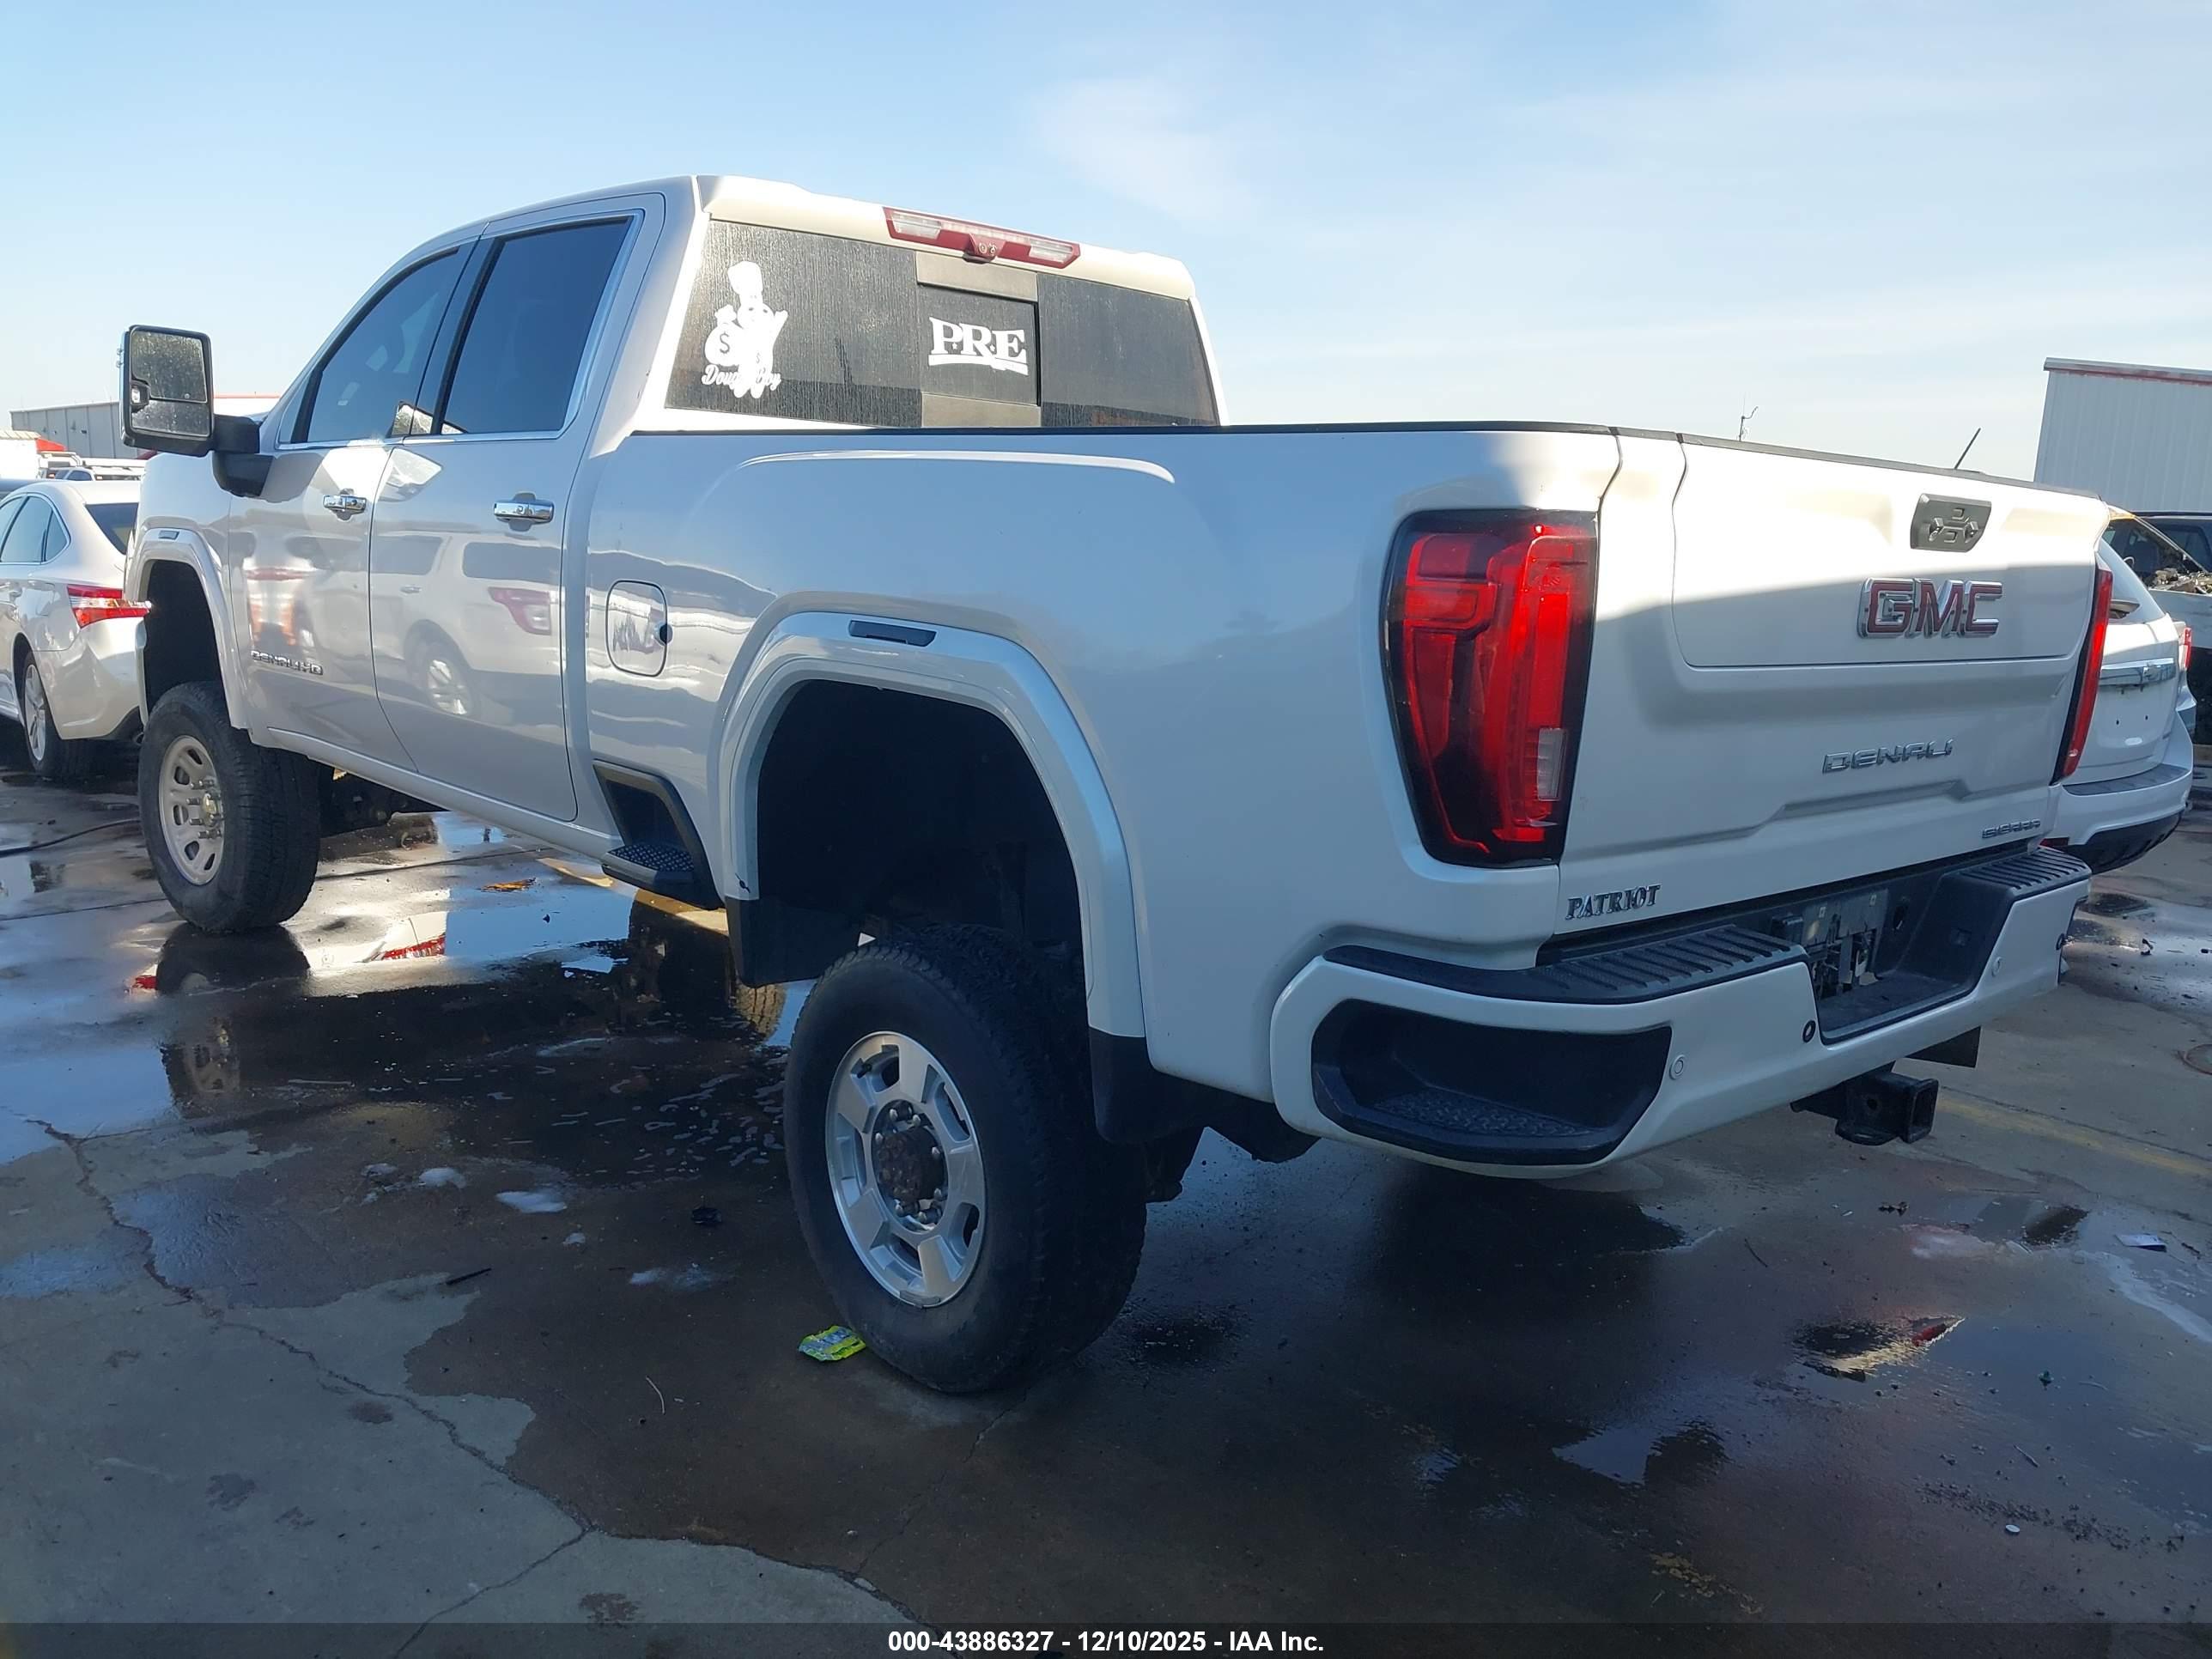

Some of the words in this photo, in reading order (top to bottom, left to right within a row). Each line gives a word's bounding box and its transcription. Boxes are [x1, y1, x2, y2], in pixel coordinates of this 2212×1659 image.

[1857, 577, 2002, 639] GMC
[251, 650, 301, 672] DENALI
[301, 660, 324, 676] HD
[1822, 738, 1954, 774] DENALI
[1982, 818, 2041, 839] SIERRA
[1565, 884, 1662, 921] PATRIOT
